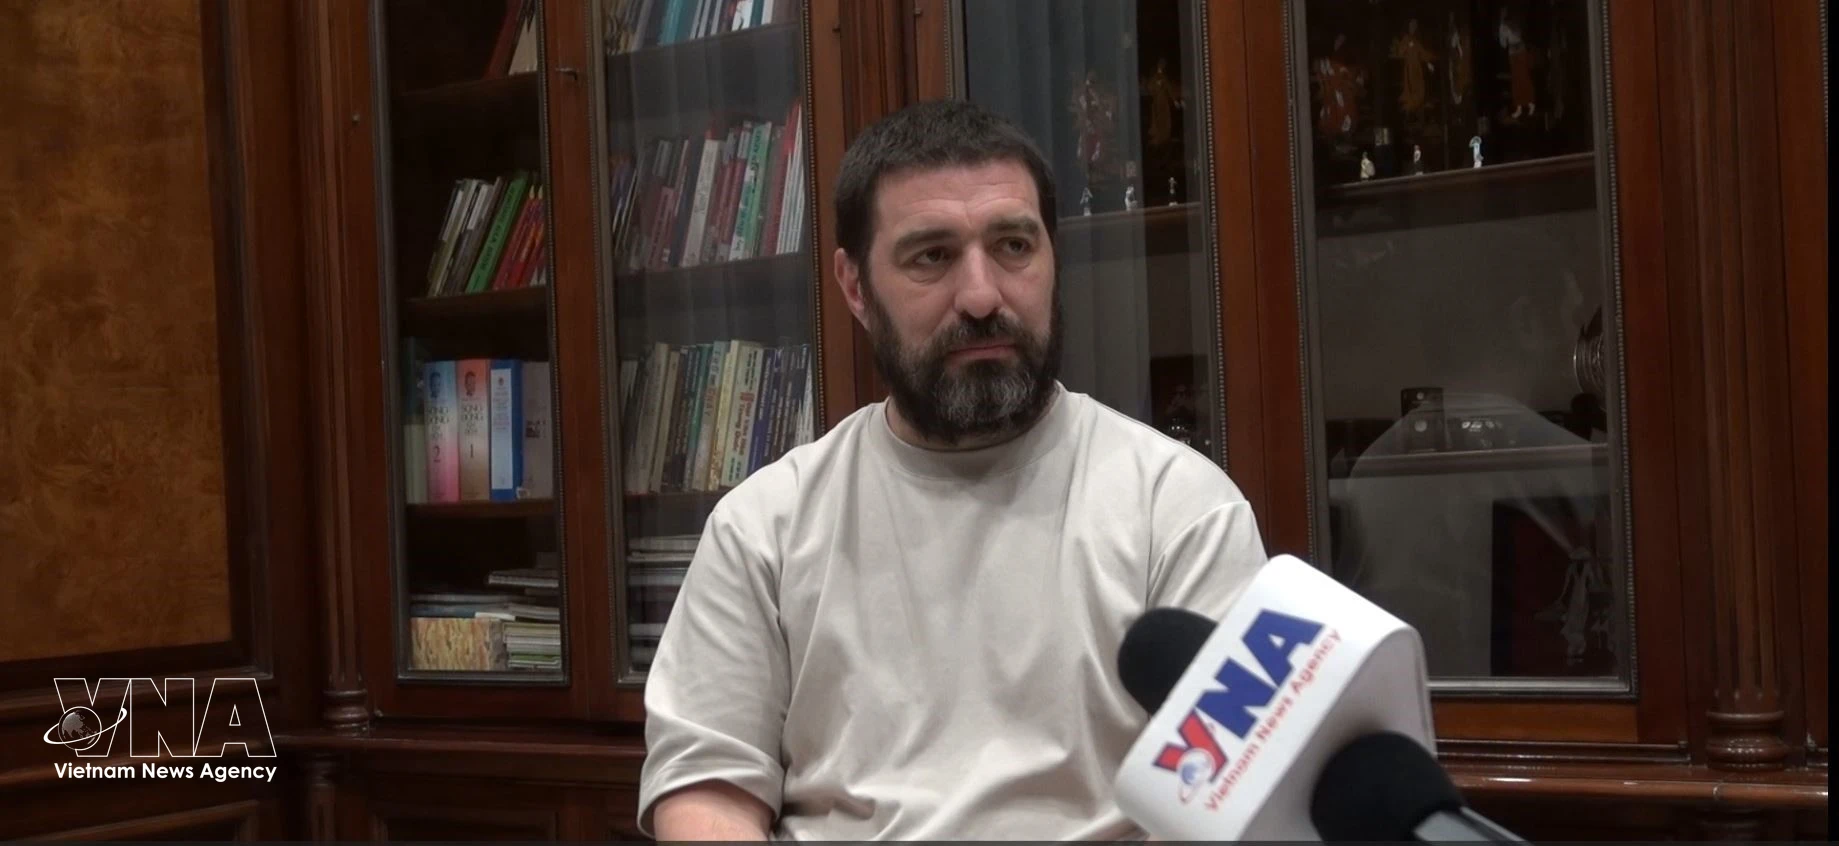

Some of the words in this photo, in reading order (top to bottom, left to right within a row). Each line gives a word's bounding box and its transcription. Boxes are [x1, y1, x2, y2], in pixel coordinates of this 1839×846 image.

[433, 445, 442, 463] 2
[1205, 740, 1260, 812] Vietnam
[1256, 697, 1293, 740] News
[1290, 629, 1343, 694] Agency
